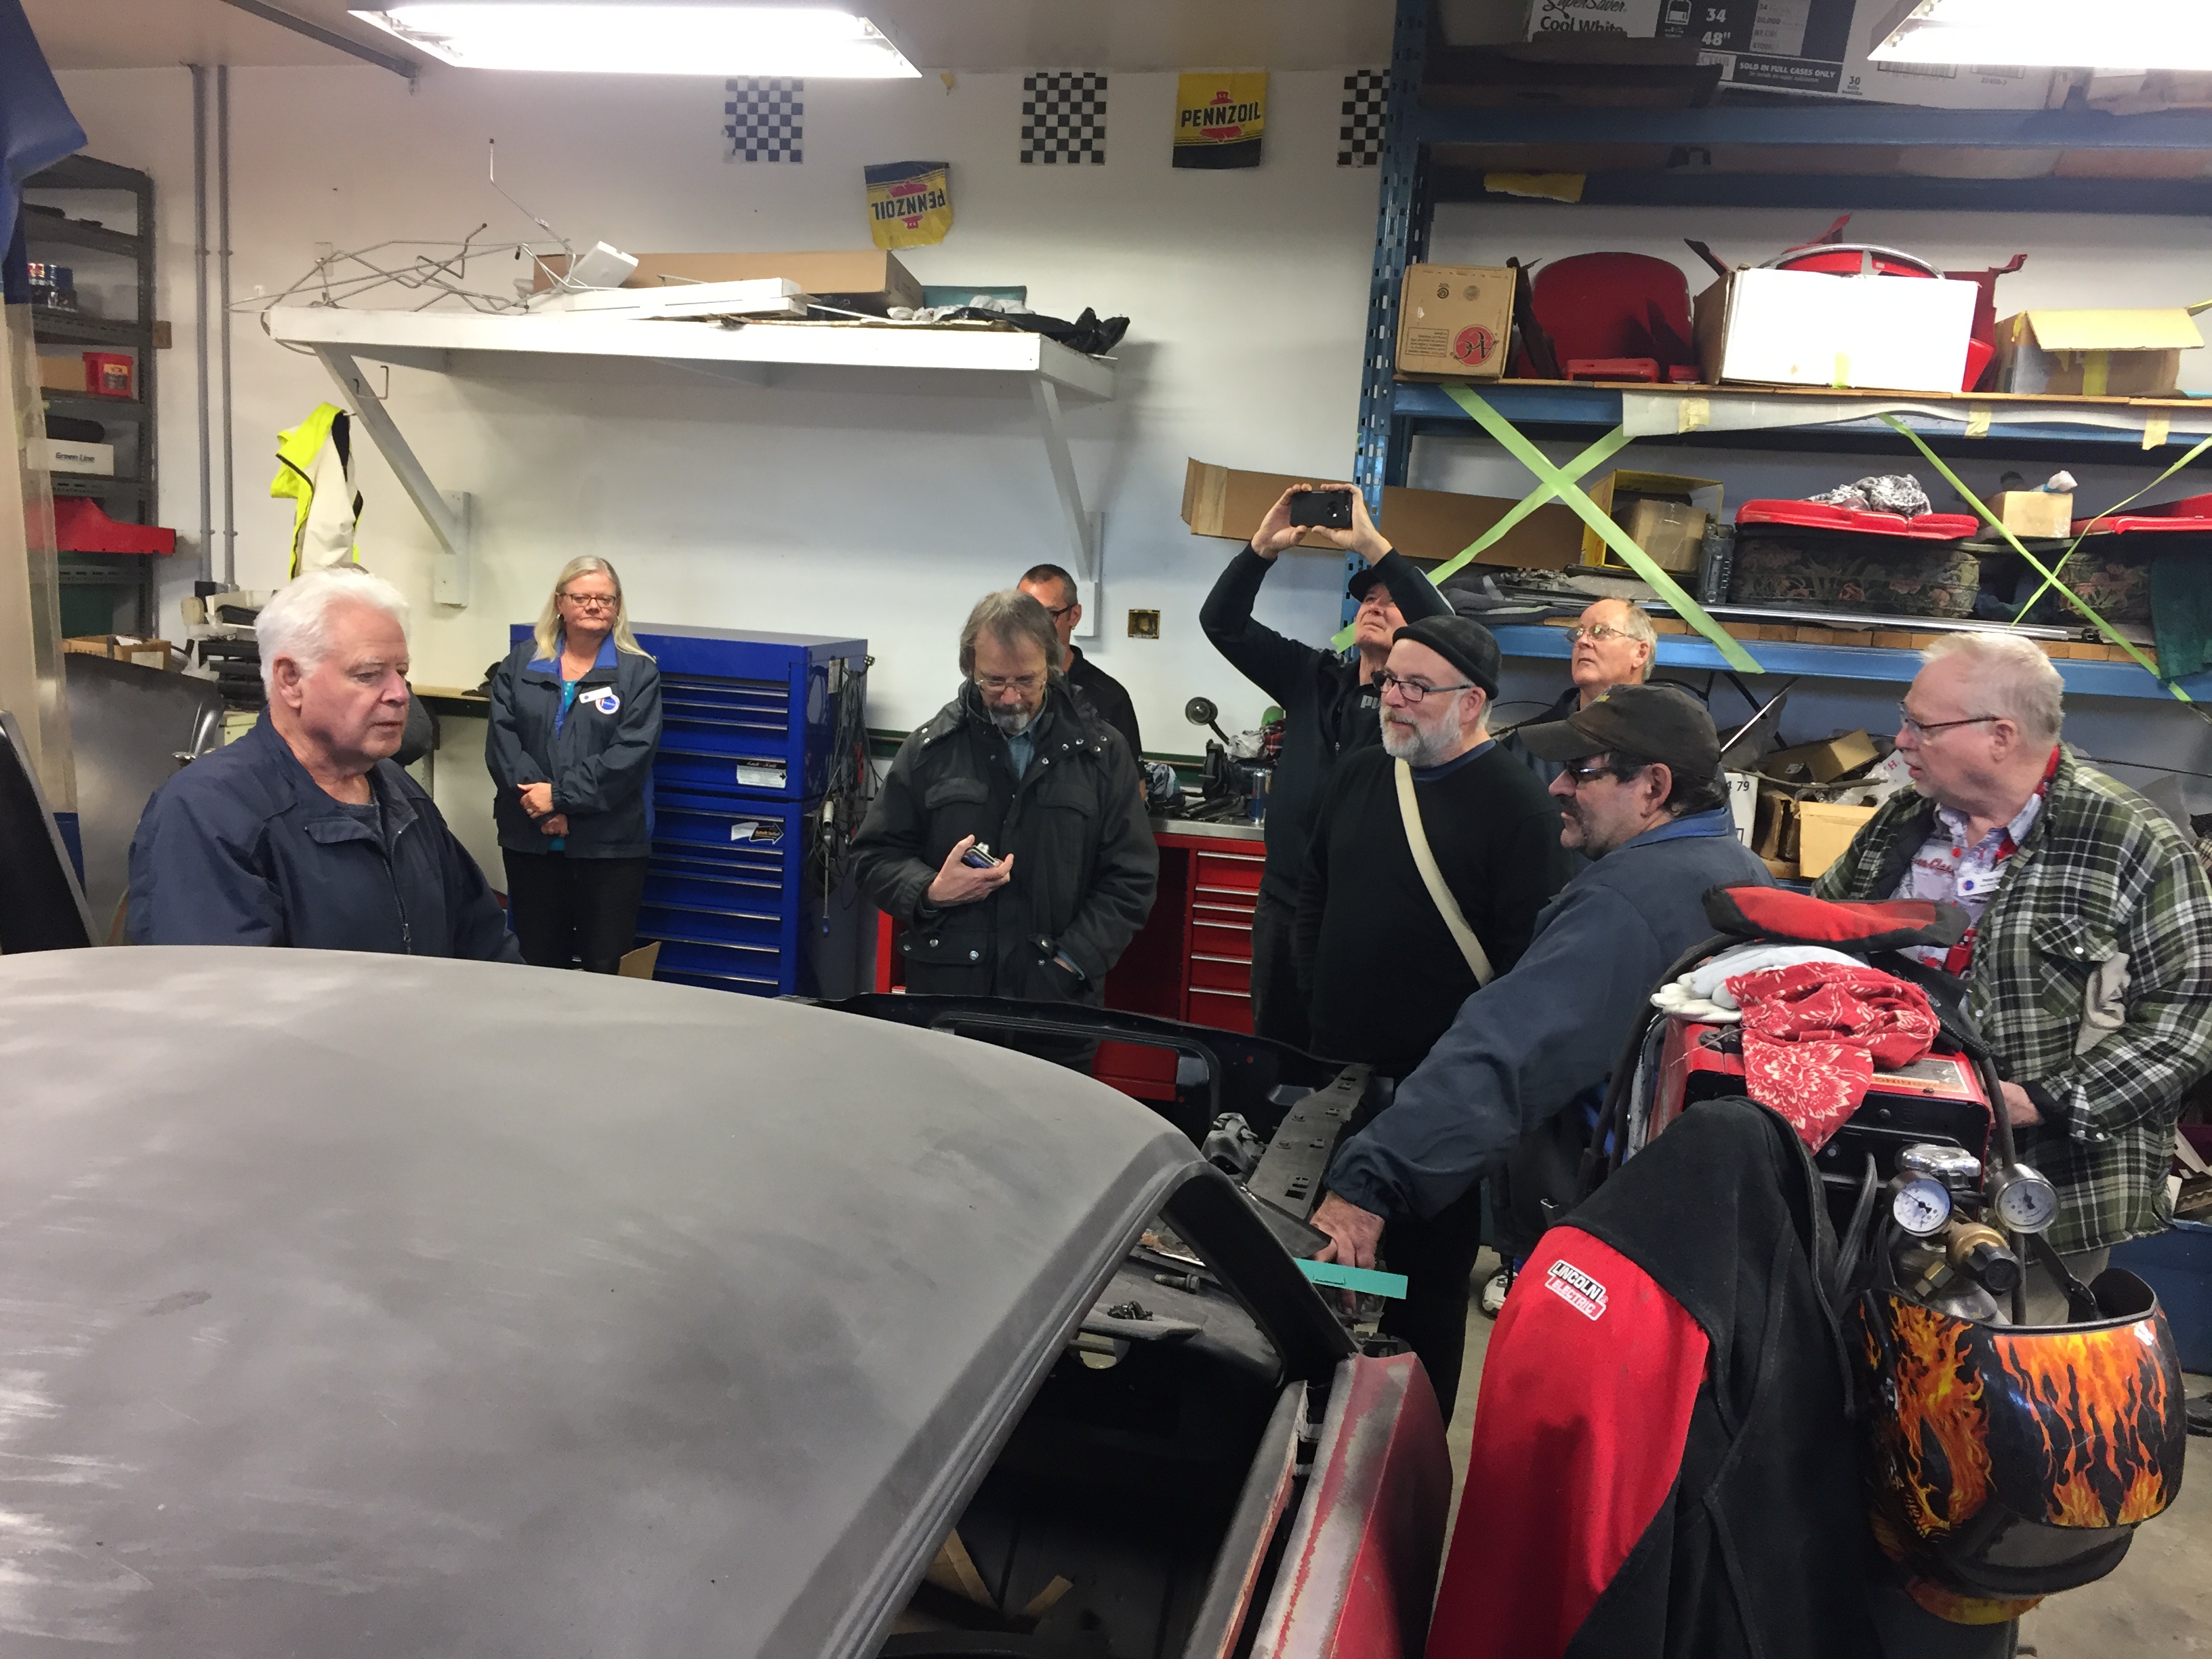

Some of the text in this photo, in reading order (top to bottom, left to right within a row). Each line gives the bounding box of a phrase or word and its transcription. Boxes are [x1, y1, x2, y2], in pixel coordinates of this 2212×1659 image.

[1706, 7, 1727, 22] 34
[1540, 16, 1575, 31] Cool
[1740, 62, 1759, 70] SOLD
[1761, 64, 1770, 72] IN
[1770, 65, 1788, 73] FULL
[1790, 67, 1814, 77] CASES
[1814, 69, 1837, 79] ONLY
[1849, 76, 1862, 86] 30
[1181, 101, 1262, 128] PENNZOIL
[871, 188, 946, 221] PENNZOIL
[1736, 781, 1750, 792] 79
[1551, 1263, 1601, 1300] LINCOLN
[1551, 1279, 1597, 1314] ELECTRIC
